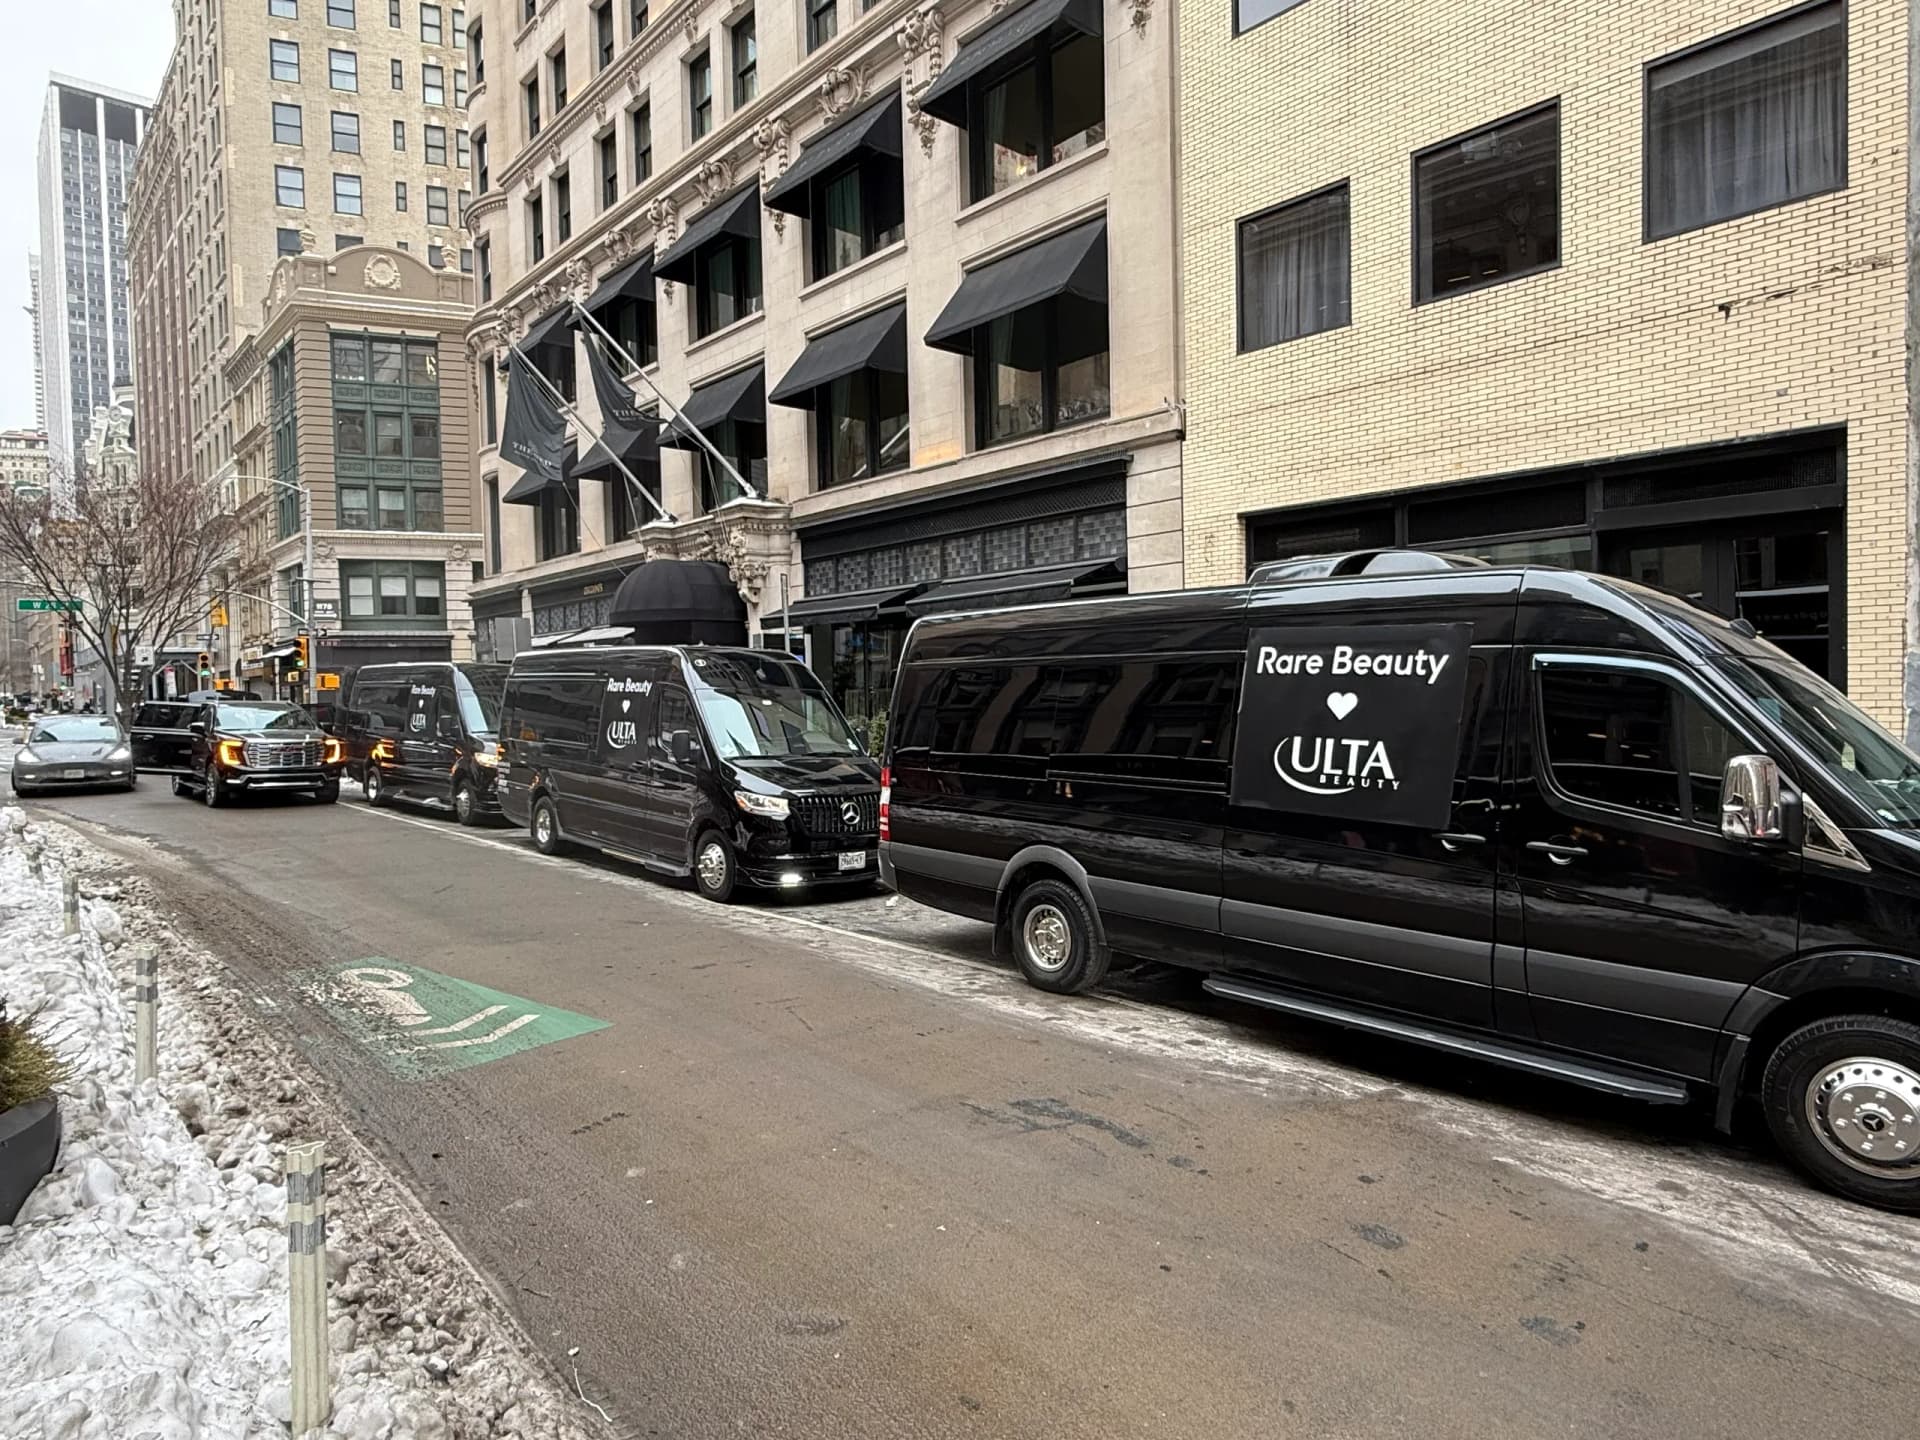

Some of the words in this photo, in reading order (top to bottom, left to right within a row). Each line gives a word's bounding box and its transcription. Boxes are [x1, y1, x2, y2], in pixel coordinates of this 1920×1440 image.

[1257, 646, 1324, 675] Rare
[1331, 646, 1449, 684] Beauty
[607, 677, 624, 692] Rare
[625, 677, 653, 697] Beauty
[611, 720, 637, 741] ULTA
[1290, 736, 1395, 780] ULTA
[1319, 774, 1401, 790] BEAUTY
